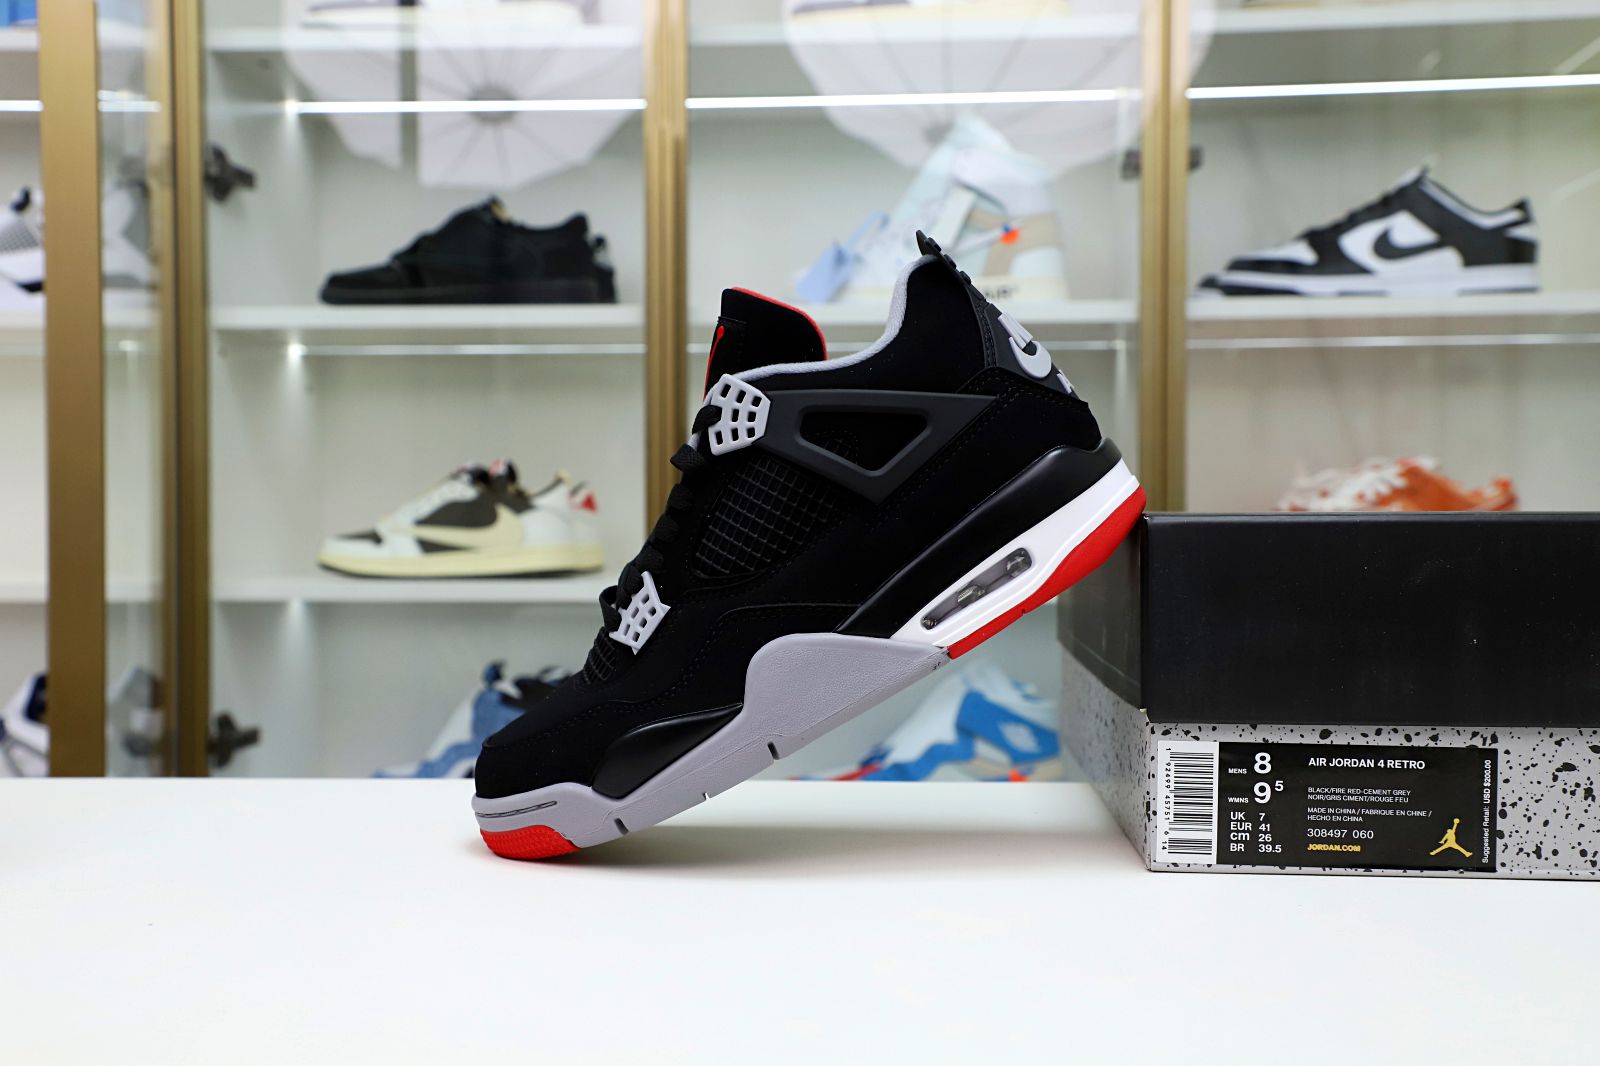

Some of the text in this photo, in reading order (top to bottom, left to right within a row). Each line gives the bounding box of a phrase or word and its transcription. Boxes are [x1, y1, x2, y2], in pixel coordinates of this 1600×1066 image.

[1253, 752, 1272, 774] 8
[1308, 757, 1425, 770] AIR JORDAN 4 RETRO
[1253, 781, 1272, 804] 9
[1274, 780, 1284, 792] 5
[1307, 786, 1346, 794] BLACK/FIRE
[1392, 789, 1411, 797] GREY
[1307, 794, 1342, 802] NOIR/GRIS
[1342, 795, 1394, 803] CIMENT/ROUGE
[1230, 811, 1266, 822] UK 7
[1361, 808, 1395, 816] FABRIQUE
[1482, 759, 1492, 863] Suggested Retail: USD $200.00
[1307, 814, 1331, 822] HECHO
[1343, 815, 1363, 823] CHINA
[1230, 821, 1271, 832] EUR 41
[1230, 832, 1272, 842] cm 26
[1307, 828, 1374, 839] 308497 060
[1161, 840, 1168, 851] 14
[1229, 842, 1282, 853] BR 39.5
[1307, 843, 1361, 852] JORDAN.COM
